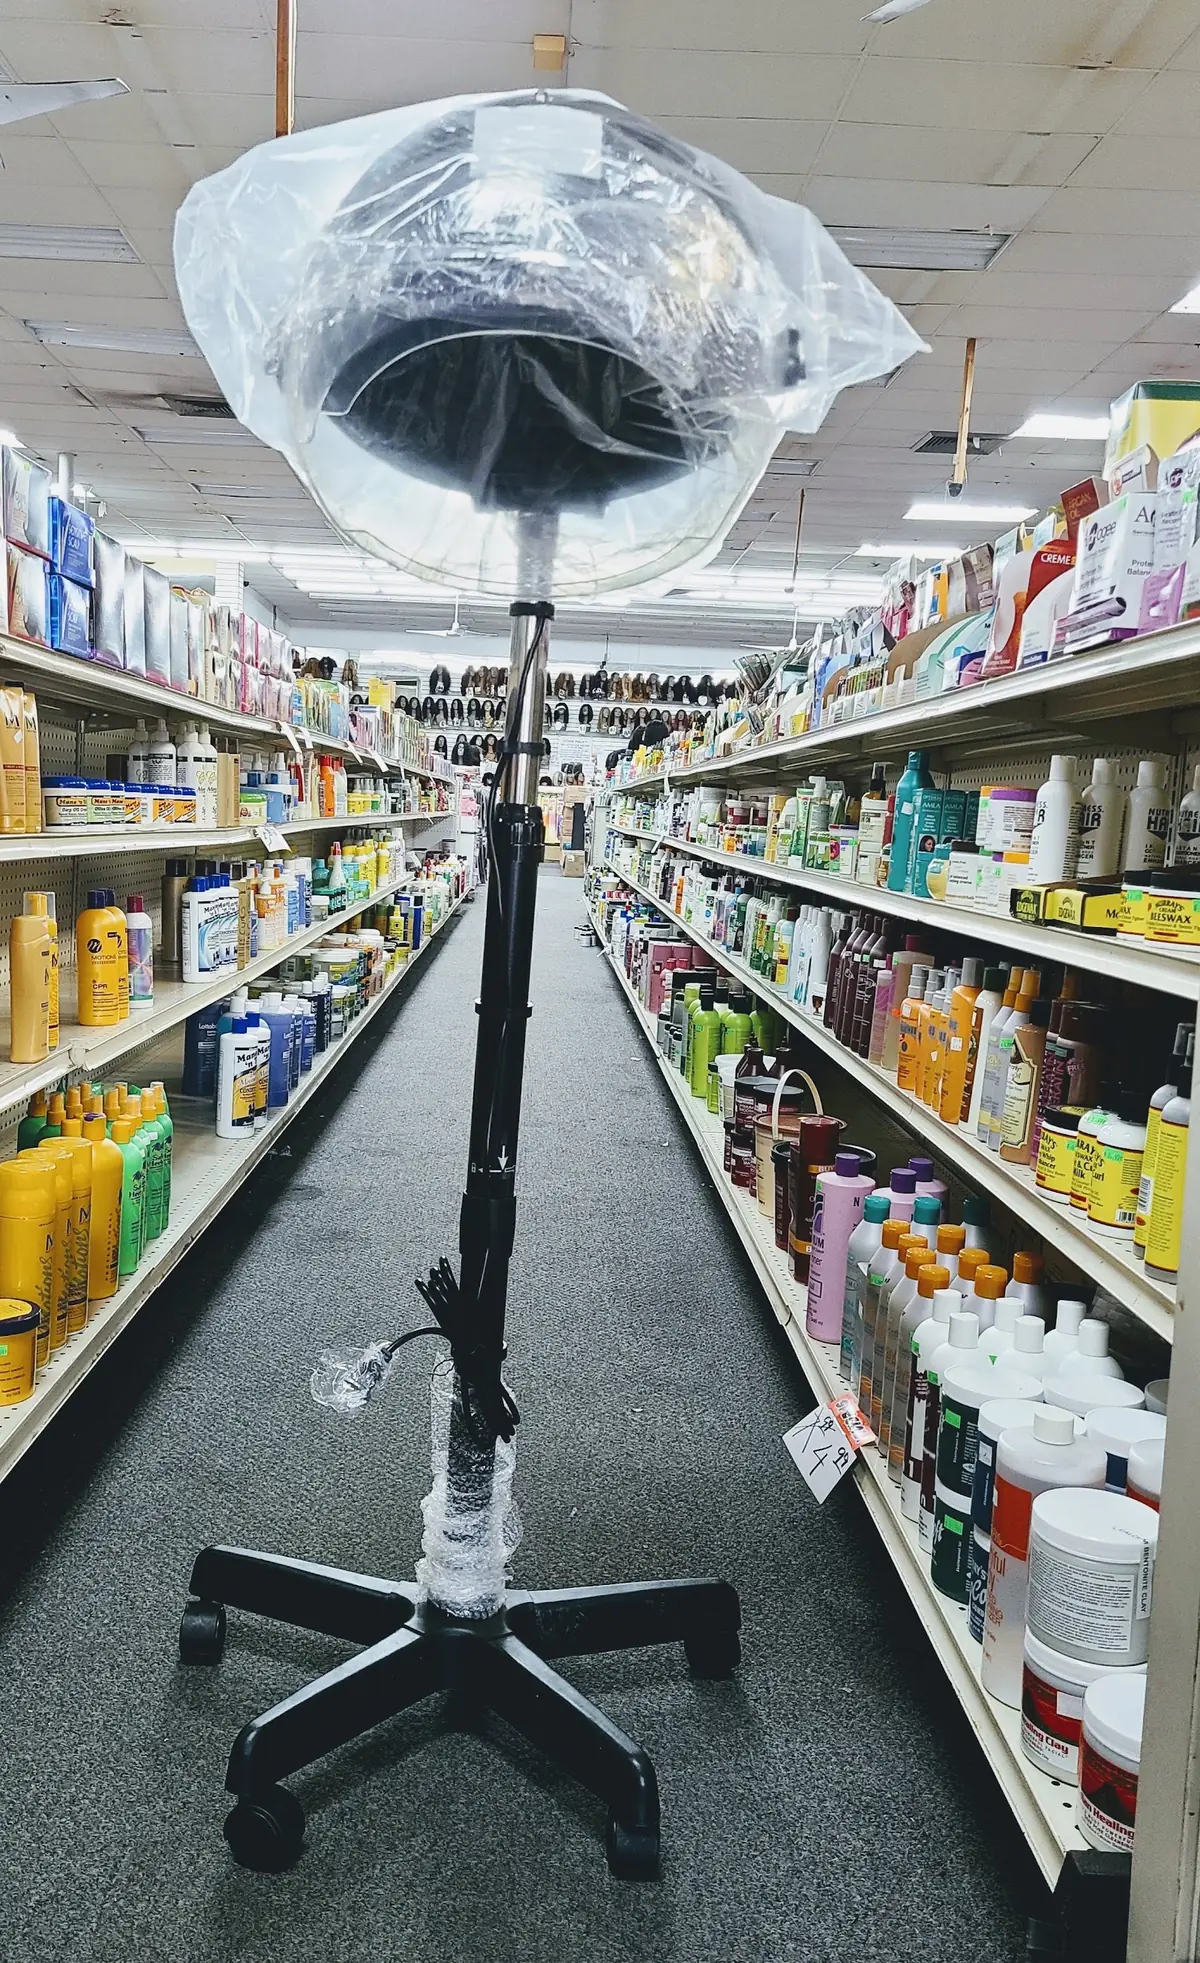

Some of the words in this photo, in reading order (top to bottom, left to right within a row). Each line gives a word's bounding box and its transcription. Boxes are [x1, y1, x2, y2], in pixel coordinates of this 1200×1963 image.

[1040, 552, 1072, 565] CREME
[1150, 912, 1192, 924] BEESWAX
[809, 1444, 833, 1476] 4
[1045, 1736, 1069, 1755] Clay
[1092, 1808, 1135, 1840] Healing
